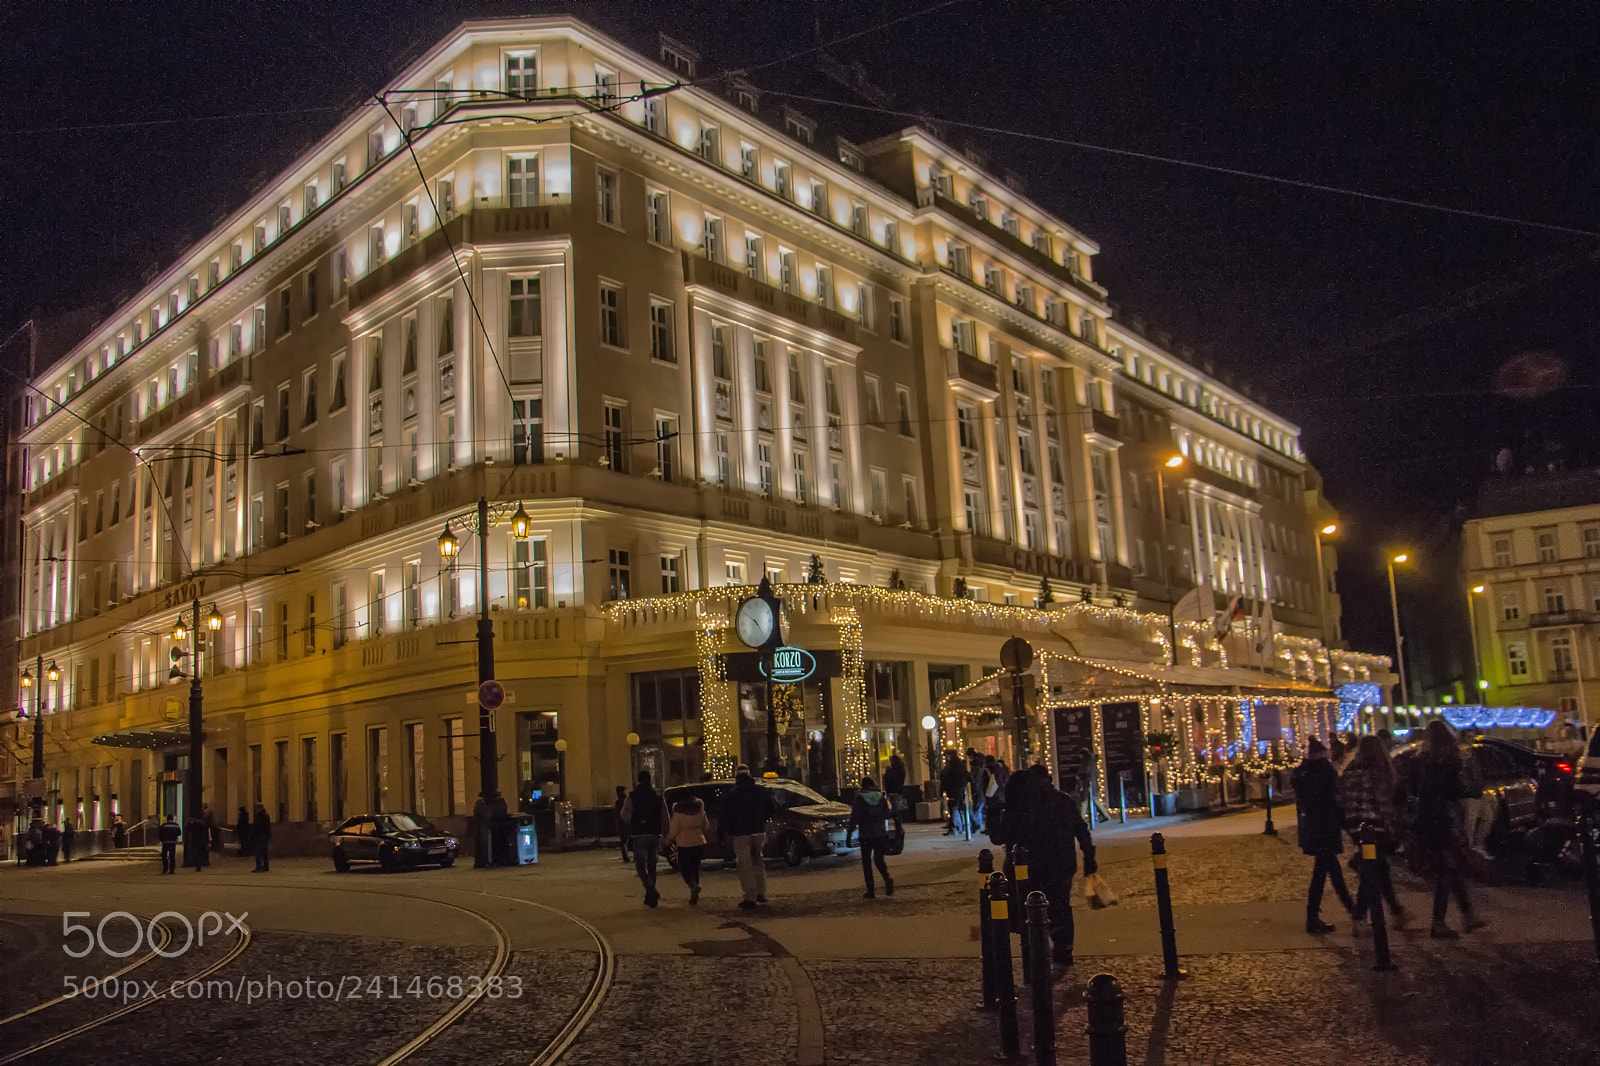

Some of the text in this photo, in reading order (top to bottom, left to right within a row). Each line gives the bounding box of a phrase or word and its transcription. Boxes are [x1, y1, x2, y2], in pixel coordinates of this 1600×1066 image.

[1014, 551, 1090, 583] CARLTON
[165, 579, 206, 608] SAVOY
[774, 651, 801, 668] KORZO
